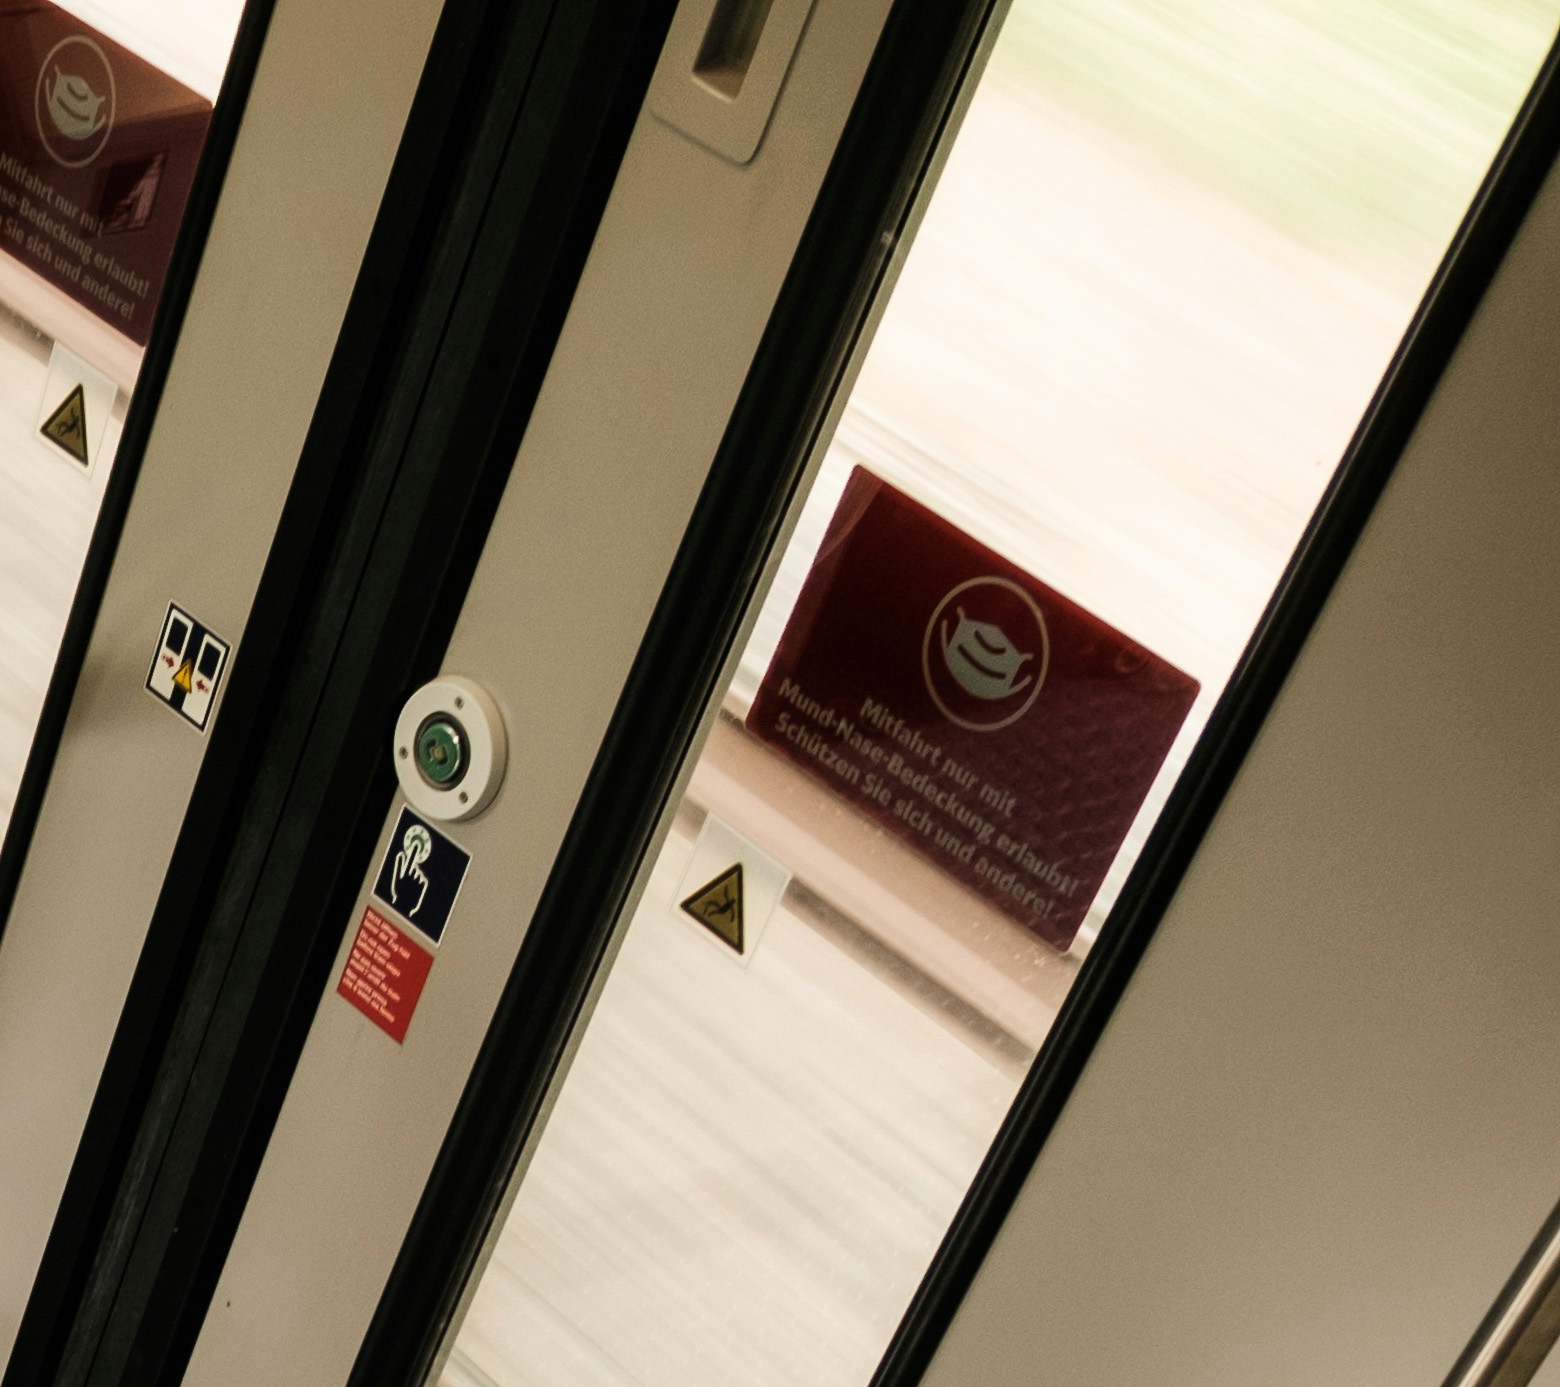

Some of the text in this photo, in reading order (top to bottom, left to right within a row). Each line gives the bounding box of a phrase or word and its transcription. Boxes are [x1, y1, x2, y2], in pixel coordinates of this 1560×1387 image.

[0, 151, 53, 204] Mitfahrt
[54, 194, 80, 219] nur
[26, 234, 53, 264] sich
[54, 254, 82, 283] und
[81, 274, 136, 321] andere!
[775, 710, 1055, 919] Schützen Sie sich und andere!
[778, 676, 996, 845] Mund-Nase-Bedeckung
[859, 696, 1017, 819] Mitfahrt nur mit
